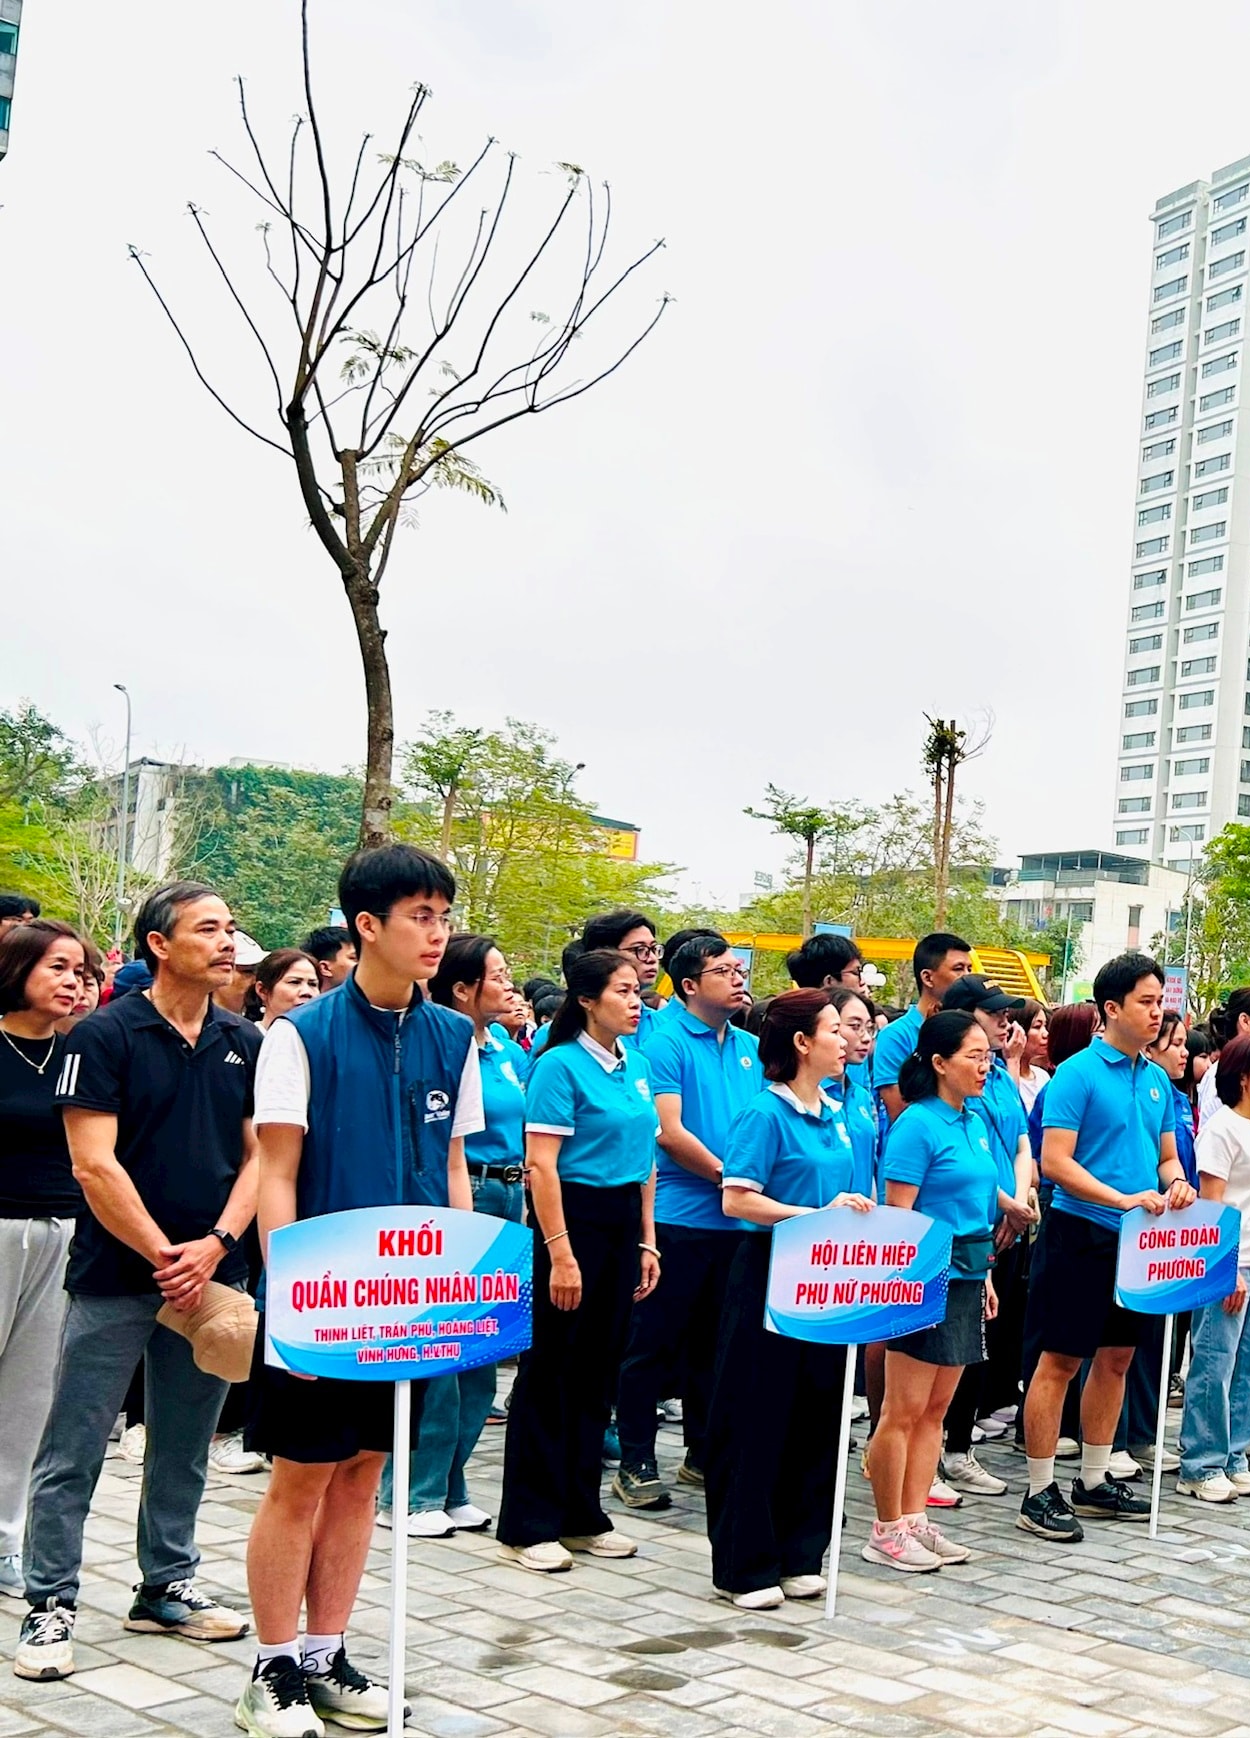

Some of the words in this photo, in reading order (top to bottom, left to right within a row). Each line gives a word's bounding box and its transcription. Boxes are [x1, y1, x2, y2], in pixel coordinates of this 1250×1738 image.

[378, 1219, 443, 1256] KHỐI
[1140, 1227, 1176, 1250] CÔNG
[1181, 1223, 1219, 1246] ĐOÀN
[810, 1239, 838, 1271] HỘI
[843, 1240, 877, 1265] LIÊN
[882, 1240, 916, 1271] HIỆP
[1147, 1255, 1205, 1281] PHƯỜNG
[354, 1273, 419, 1307] CHÚNG
[426, 1271, 476, 1304] NHÂN
[482, 1268, 519, 1302] DÂN
[795, 1283, 829, 1310] PHỤ
[833, 1278, 857, 1304] NỮ
[860, 1277, 923, 1304] PHƯỜNG
[314, 1327, 348, 1345] THỊNH
[438, 1319, 474, 1335] HOÀNG
[357, 1346, 384, 1363] VĨNH
